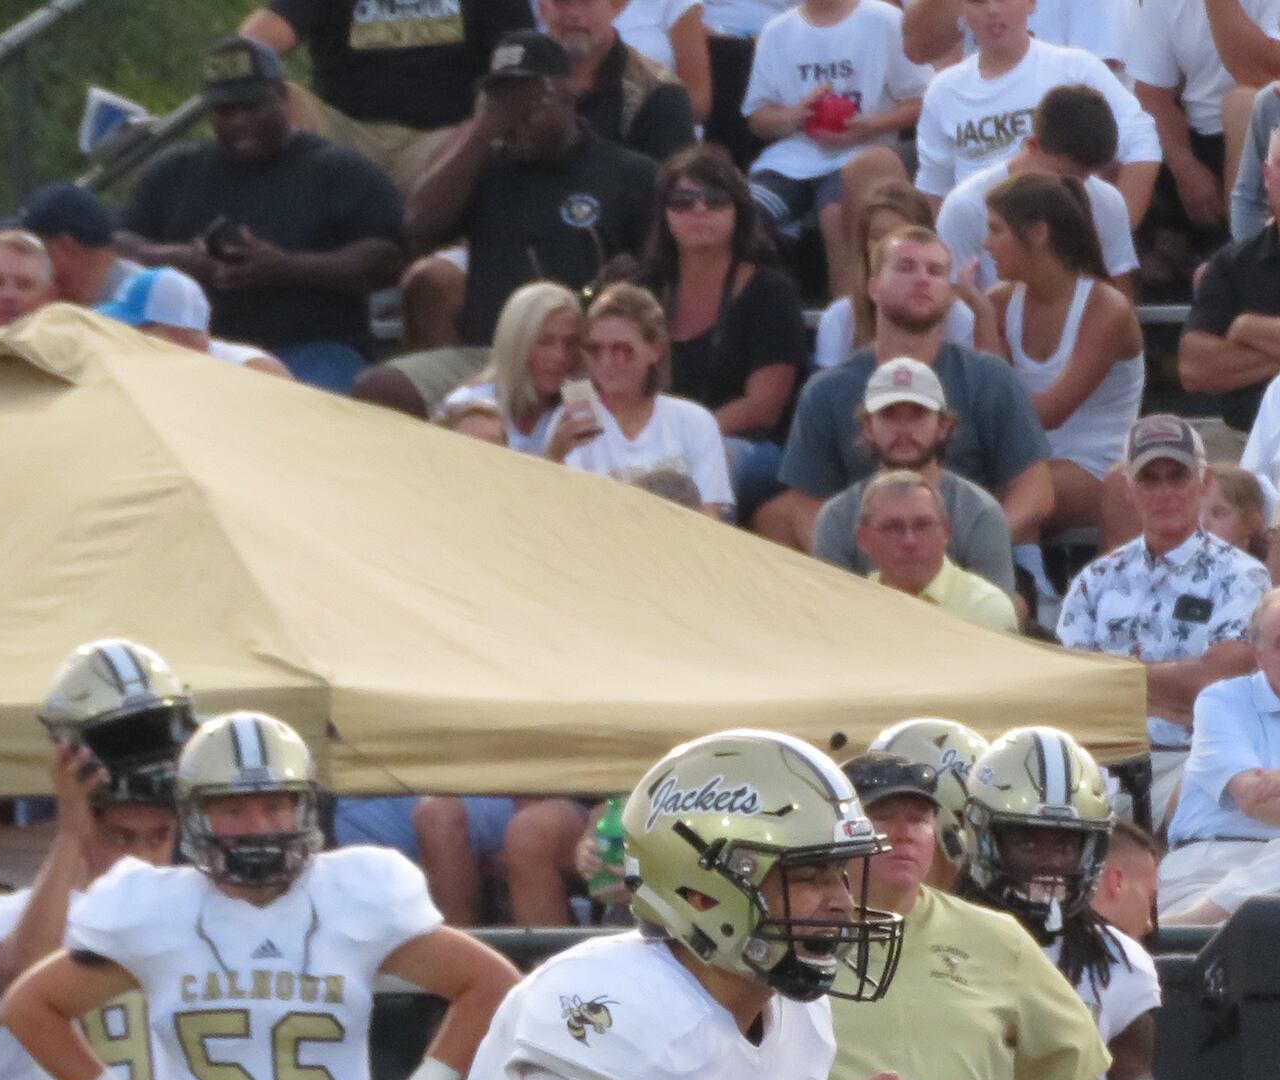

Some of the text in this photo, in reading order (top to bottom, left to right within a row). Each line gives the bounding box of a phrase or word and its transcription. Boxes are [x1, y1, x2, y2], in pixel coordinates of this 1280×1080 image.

[796, 59, 854, 83] THIS
[643, 773, 763, 832] Jackets
[179, 968, 346, 1004] CALHOUN
